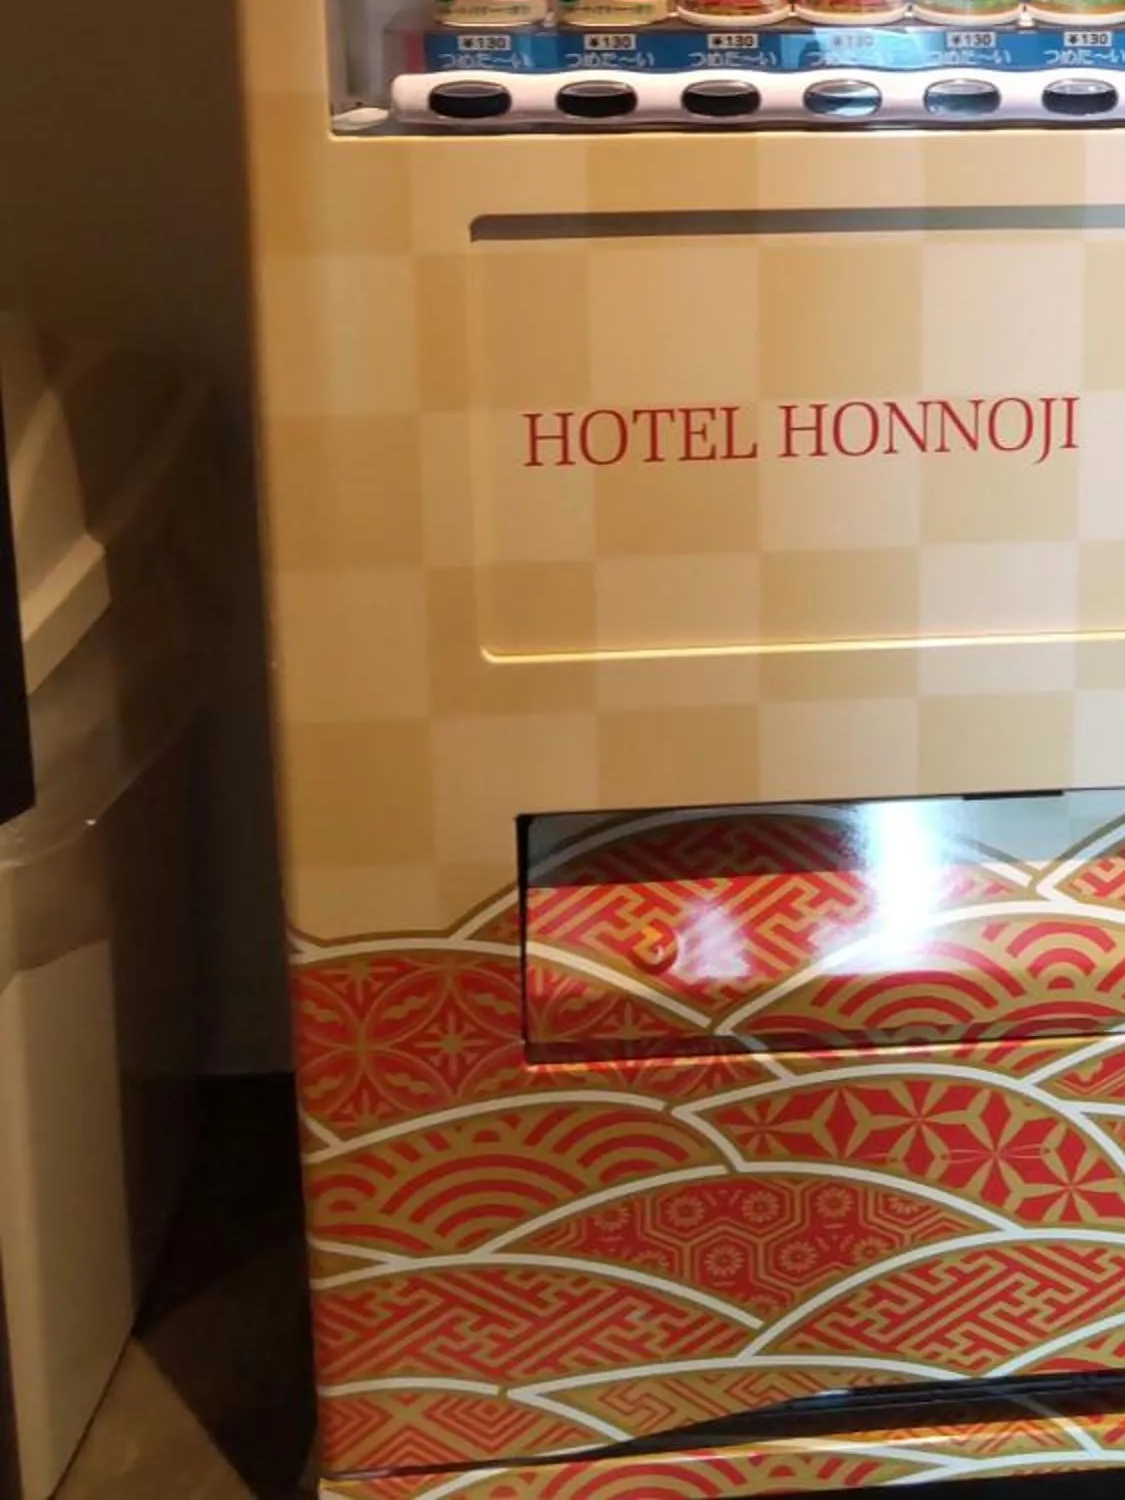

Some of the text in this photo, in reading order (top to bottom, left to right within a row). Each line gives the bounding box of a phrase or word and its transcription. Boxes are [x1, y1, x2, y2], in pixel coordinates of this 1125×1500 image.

[711, 35, 755, 47] ¥130
[951, 33, 992, 45] ¥130
[1067, 33, 1109, 45] ¥130
[523, 396, 1081, 467] HOTEL HONNOJI
